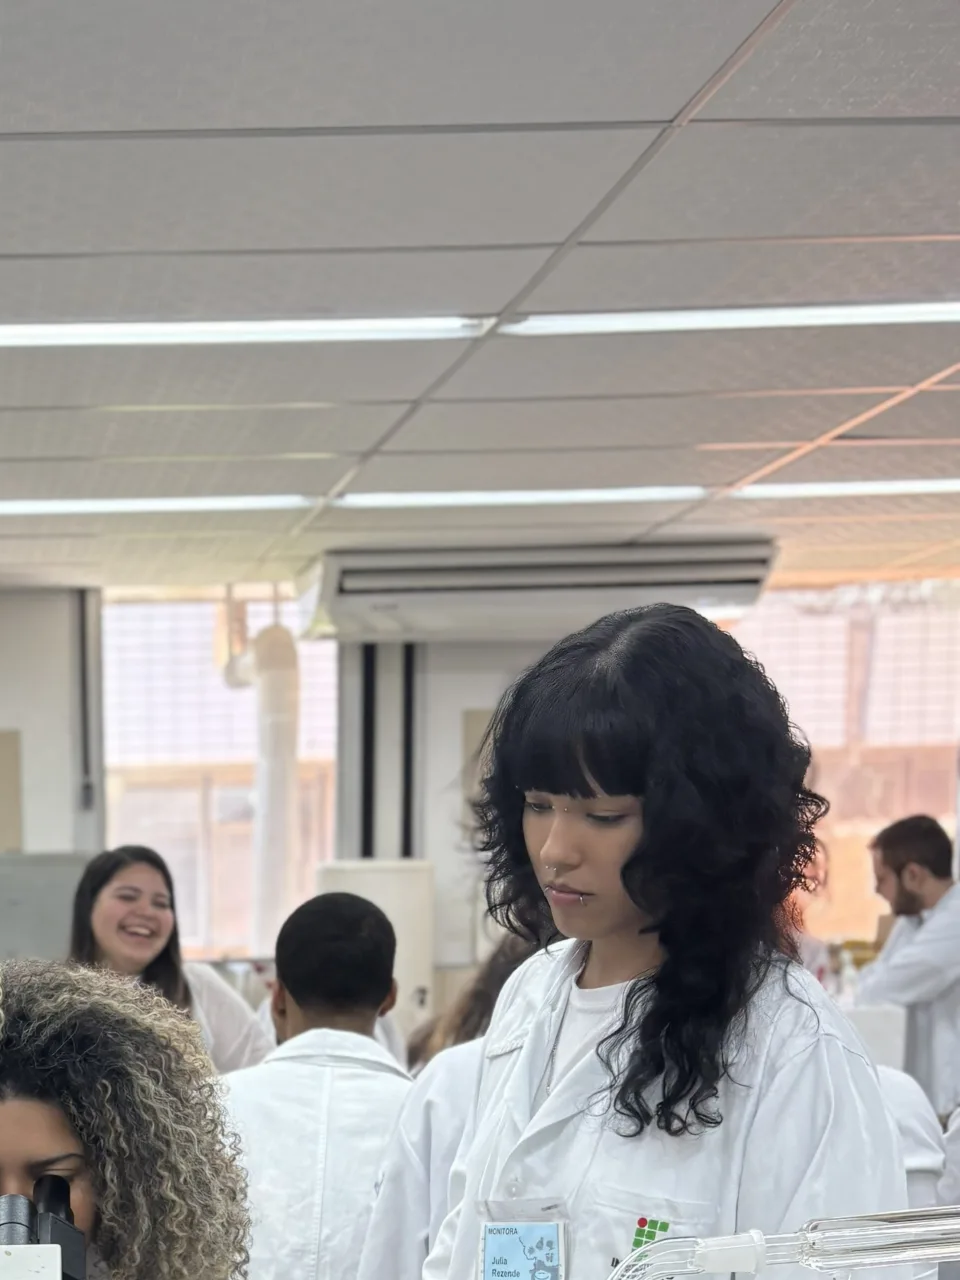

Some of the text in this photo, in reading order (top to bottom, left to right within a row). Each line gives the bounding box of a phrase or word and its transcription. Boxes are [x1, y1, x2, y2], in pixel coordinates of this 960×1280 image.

[488, 1227, 518, 1235] MONITORA
[492, 1256, 508, 1265] Julia
[492, 1268, 520, 1277] Rezende
